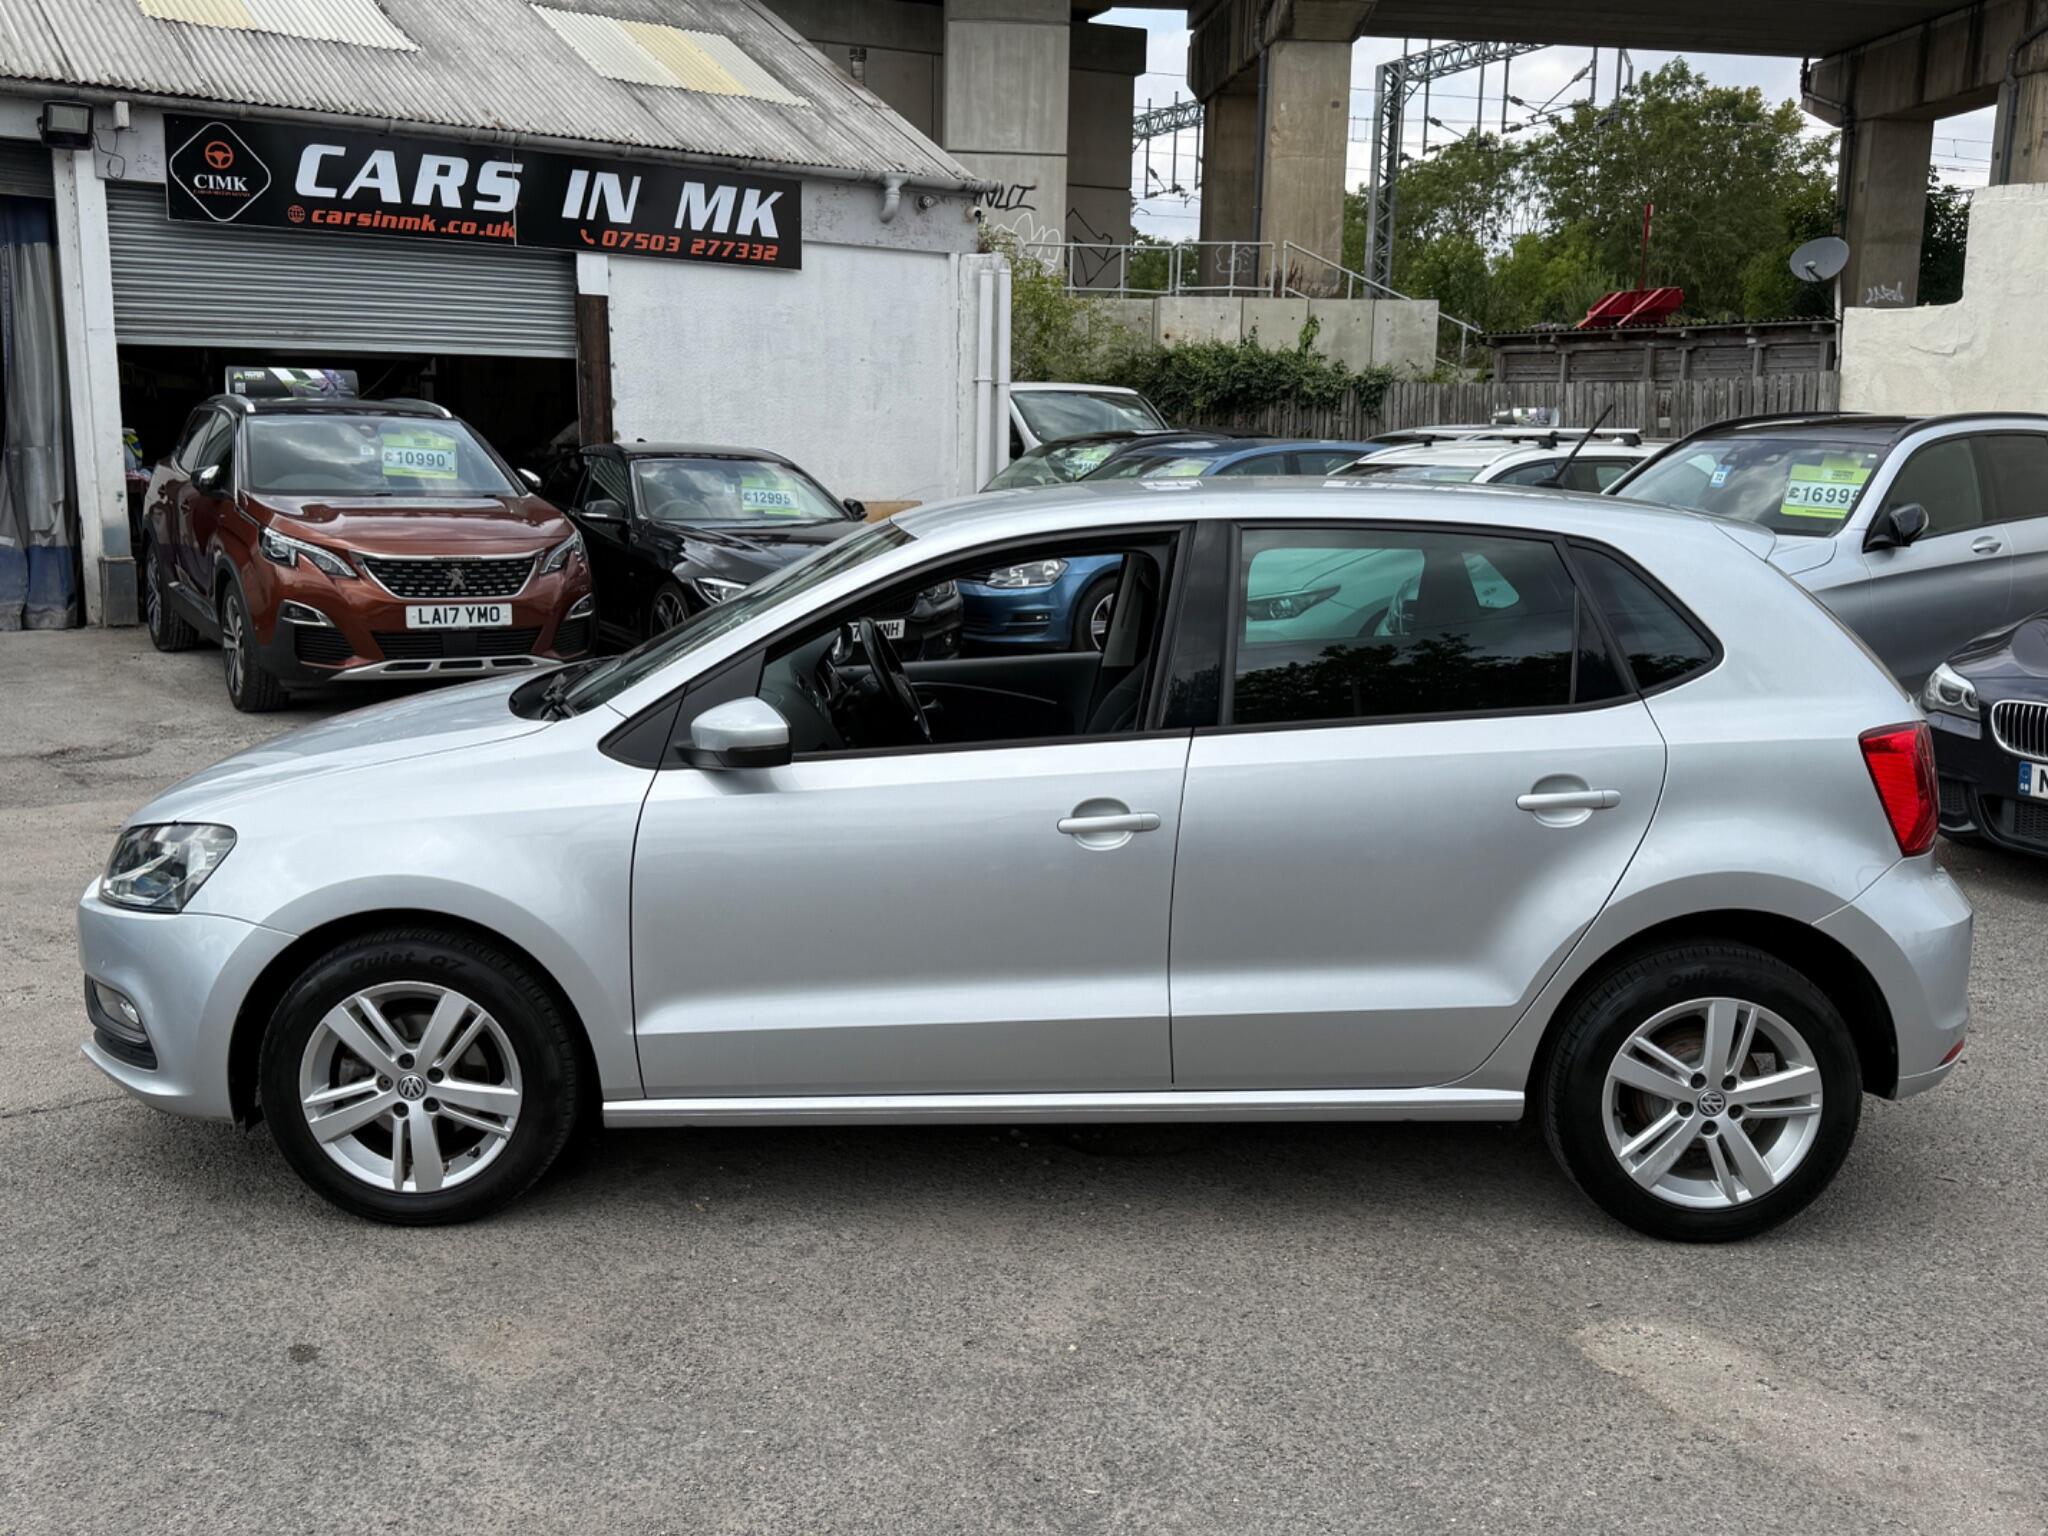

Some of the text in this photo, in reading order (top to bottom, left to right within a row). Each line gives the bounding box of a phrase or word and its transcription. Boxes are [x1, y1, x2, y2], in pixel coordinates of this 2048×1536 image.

[193, 173, 249, 191] CIMK
[295, 143, 784, 239] CARS IN MK
[311, 209, 517, 238] carsinmk.co.uk
[602, 229, 778, 262] 07503 277332
[384, 450, 446, 468] £10990
[418, 606, 500, 625] LA17 YMO
